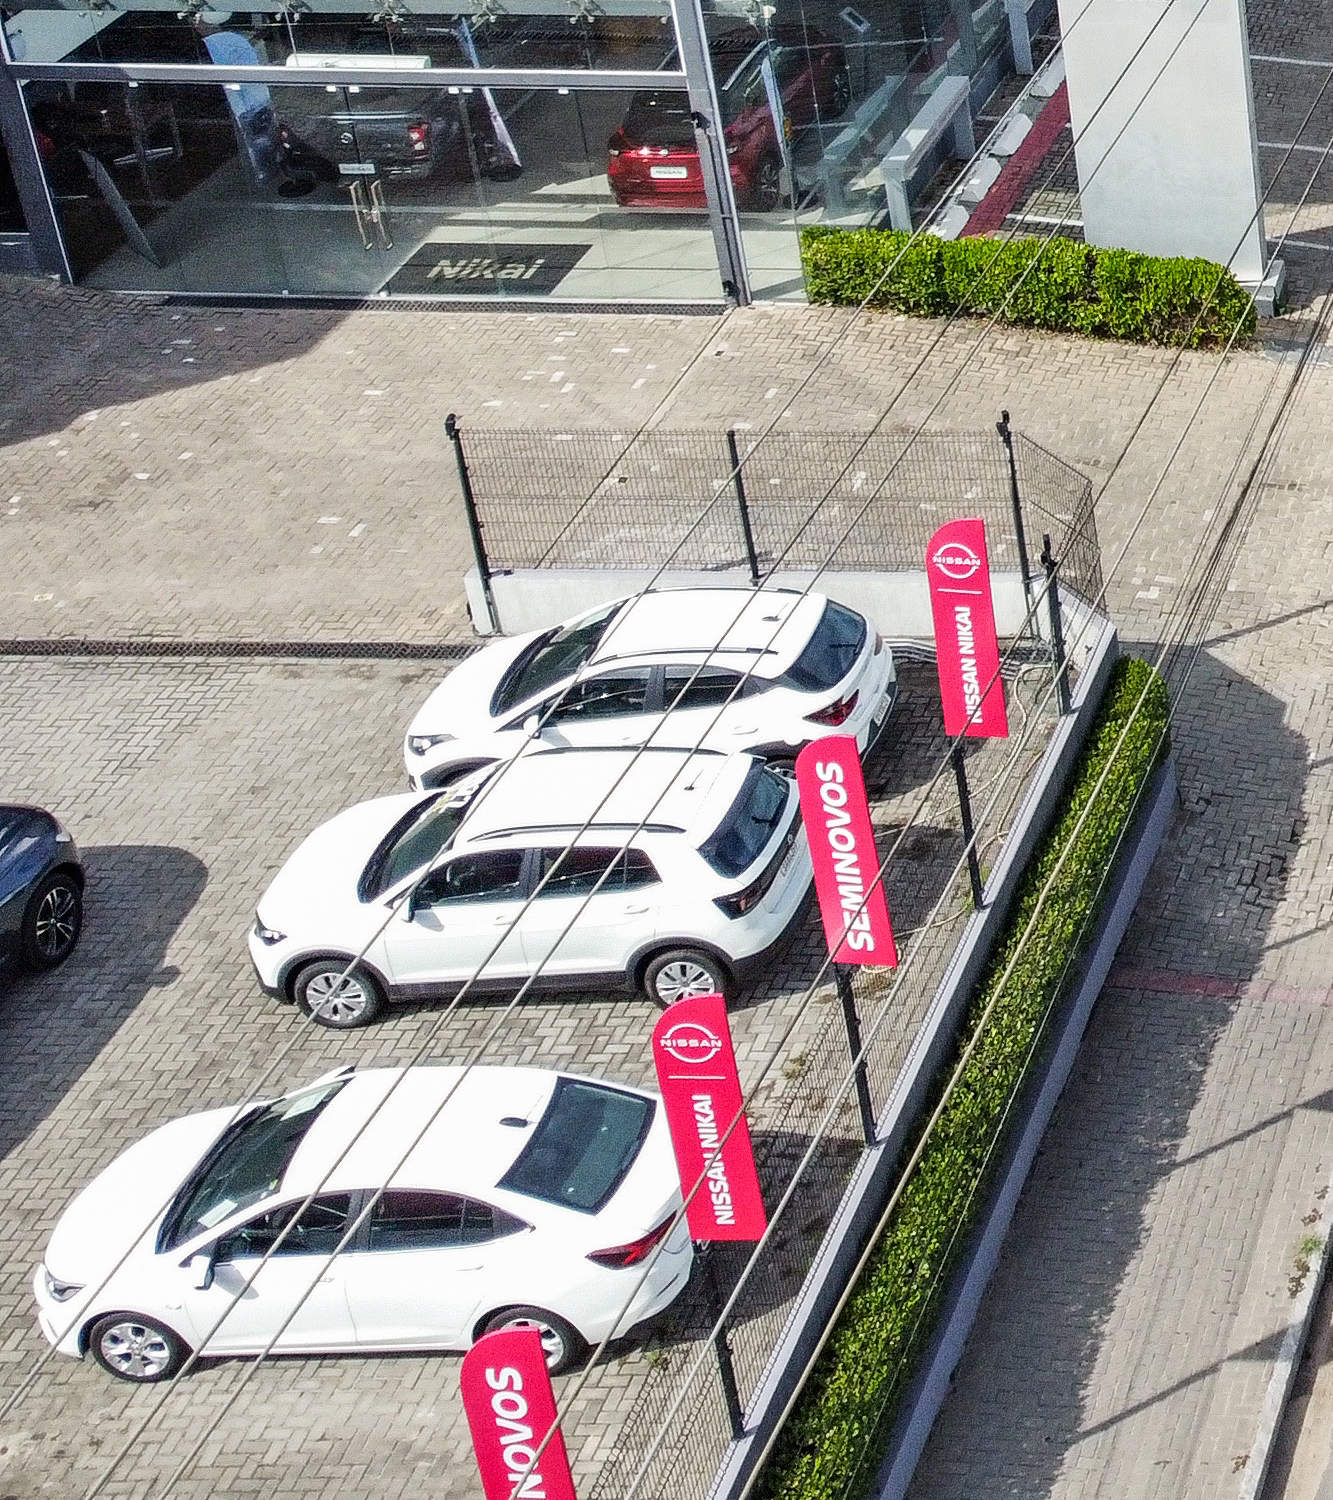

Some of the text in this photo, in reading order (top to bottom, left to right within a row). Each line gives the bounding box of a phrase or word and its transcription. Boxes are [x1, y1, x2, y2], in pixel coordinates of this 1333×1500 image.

[426, 258, 546, 279] Nikai
[932, 556, 981, 566] NISSAN
[954, 606, 983, 724] NISSAN NIKAI
[815, 761, 875, 952] SEMINOVOS
[660, 1039, 722, 1048] NISSAN
[691, 1094, 736, 1226] NISSAN NIKAI
